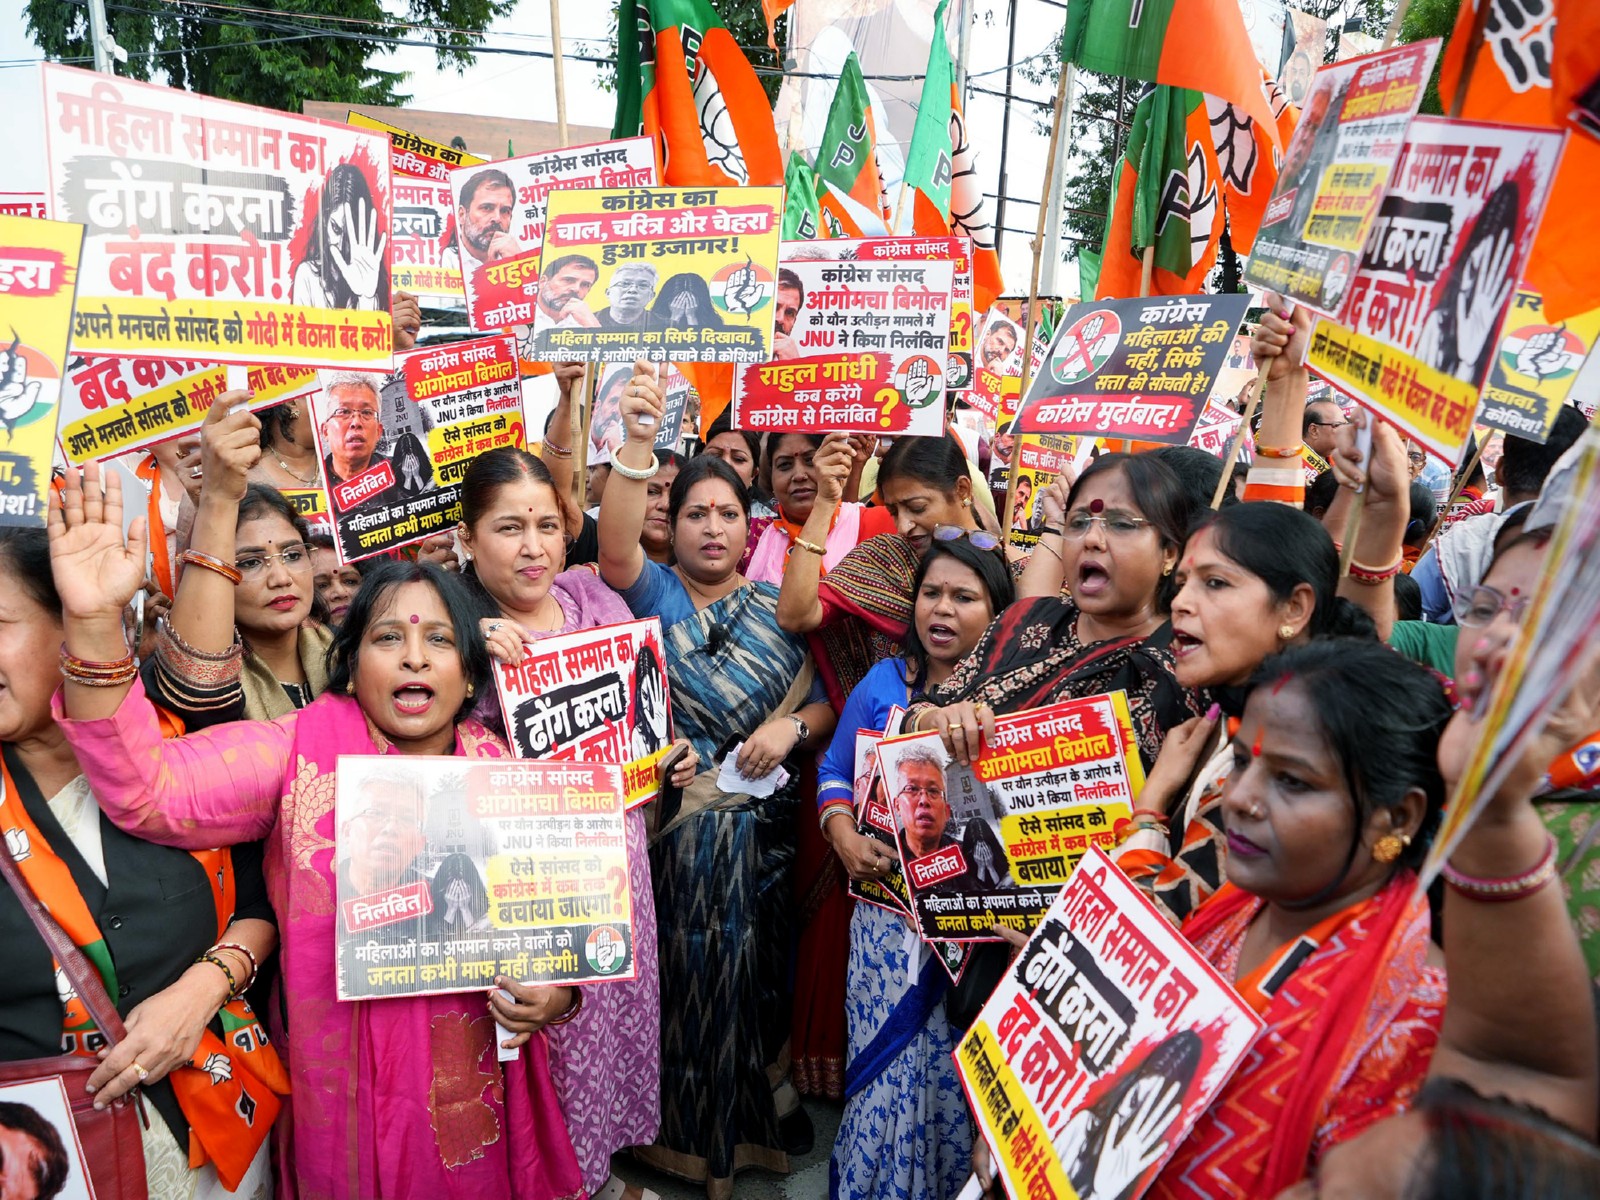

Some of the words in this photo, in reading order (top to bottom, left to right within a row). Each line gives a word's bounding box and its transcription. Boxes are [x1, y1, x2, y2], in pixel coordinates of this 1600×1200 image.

[57, 83, 174, 158] महिला
[182, 114, 281, 171] सम्मान
[288, 132, 327, 175] का
[440, 150, 463, 165] का
[528, 154, 577, 177] कांग्रेस
[581, 148, 627, 167] सांसद
[86, 158, 174, 230] ढोंग
[183, 180, 285, 235] करना
[602, 190, 677, 210] कांग्रेस
[683, 190, 717, 205] का
[556, 220, 608, 242] चाल,
[612, 214, 665, 235] चरित्र
[670, 212, 707, 233] और
[713, 210, 768, 233] चेहरा
[106, 224, 176, 302] बंद
[186, 230, 282, 299] करो!
[601, 243, 647, 265] हुआ
[652, 237, 738, 257] उजागर!
[874, 242, 912, 258] कांग्रेस
[915, 241, 949, 253] सांसद
[822, 264, 871, 283] कांग्रेस
[877, 265, 926, 282] सांसद
[806, 285, 888, 309] आंगोमचा
[893, 286, 947, 310] बिमोल
[1139, 299, 1211, 324] कांग्रेस
[75, 304, 112, 339] अपने
[118, 307, 170, 341] मनचले
[175, 312, 219, 344] सांसद
[223, 311, 243, 344] को
[246, 311, 278, 348] गोदी
[281, 311, 294, 345] में
[297, 315, 335, 349] बैठाना
[339, 317, 359, 349] बंद
[361, 318, 391, 351] करो!
[483, 302, 531, 327] कांग्रेस
[810, 313, 824, 326] को
[827, 312, 847, 326] यौन
[894, 315, 922, 327] मामले
[925, 313, 935, 327] में
[550, 329, 593, 345] महिला
[596, 331, 638, 344] सम्मान
[643, 331, 661, 343] का
[665, 328, 698, 343] सिर्फ
[701, 329, 756, 344] दिखावा,
[800, 331, 834, 347] JNU
[838, 331, 849, 346] ने
[853, 332, 886, 347] किया
[890, 332, 945, 349] निलंबित
[1124, 324, 1200, 348] महिलाओं
[1200, 320, 1230, 343] की
[421, 352, 460, 372] कांग्रेस
[462, 346, 496, 363] सांसद
[651, 348, 666, 361] को
[669, 348, 697, 361] बचाने
[700, 347, 715, 361] की
[716, 348, 763, 362] कोशिश!
[1125, 348, 1159, 372] नहीं,
[1163, 346, 1206, 369] सिर्फ
[414, 373, 473, 397] आंगोमचा
[475, 361, 512, 383] बिमोल
[760, 363, 818, 392] राहुल
[823, 354, 878, 382] गांधी
[1095, 374, 1126, 391] सत्ता
[1128, 373, 1146, 390] की
[1148, 372, 1191, 392] सोचती
[1192, 371, 1210, 394] है!
[794, 389, 819, 402] कब
[826, 384, 862, 401] करेंगे
[68, 424, 98, 455] अपने
[96, 409, 137, 444] मनचले
[135, 402, 173, 431] सांसद
[171, 390, 190, 418] को
[437, 411, 457, 423] JNU
[459, 407, 465, 418] ने
[467, 404, 484, 417] किया
[487, 396, 520, 412] निलंबित!
[750, 405, 798, 426] कांग्रेस
[803, 406, 817, 424] से
[819, 406, 877, 424] निलंबित
[1036, 396, 1097, 425] कांग्रेस
[1096, 396, 1182, 430] मुर्दाबाद!
[1486, 407, 1543, 434] कोशिश!
[444, 427, 460, 443] ऐसे
[463, 422, 491, 439] सांसद
[494, 417, 506, 430] को
[434, 444, 464, 463] कांग्रेस
[477, 437, 493, 450] कब
[495, 433, 509, 446] तक
[340, 471, 387, 504] निलंबित
[563, 638, 615, 680] सम्मान
[615, 634, 635, 662] का
[525, 697, 571, 751] ढोंग
[571, 681, 623, 729] करना
[1036, 713, 1081, 740] सांसद
[980, 749, 1054, 779] आंगोमचा
[1057, 733, 1110, 763] बिमोल
[490, 768, 543, 788] कांग्रेस
[547, 764, 593, 786] सांसद
[1002, 779, 1014, 792] पर
[1015, 776, 1032, 789] यौन
[1070, 769, 1080, 783] के
[1083, 766, 1112, 782] आरोप
[1113, 764, 1122, 778] में
[1010, 795, 1034, 810] JNU
[1038, 790, 1046, 805] ने
[1048, 788, 1072, 804] किया
[1074, 782, 1126, 800] निलंबित!
[1019, 816, 1042, 834] ऐसे
[1045, 811, 1084, 831] सांसद
[1090, 807, 1106, 825] को
[914, 855, 959, 884] निलंबित
[351, 892, 422, 925] निलंबित
[498, 898, 554, 923] बचाया
[355, 940, 416, 962] महिलाओं
[420, 940, 439, 957] का
[442, 938, 488, 956] अपमान
[493, 934, 520, 952] करने
[524, 934, 553, 950] वालों
[556, 930, 572, 947] को
[1063, 866, 1119, 942] महिला
[1100, 912, 1170, 1001] सम्मान
[1153, 966, 1198, 1031] का
[368, 968, 415, 988] जनता
[420, 960, 457, 982] कभी
[461, 960, 495, 980] माफ
[531, 953, 579, 974] करेगी!
[1059, 973, 1126, 1066] करना
[996, 988, 1040, 1066] बंद
[1021, 1022, 1088, 1128] करो!
